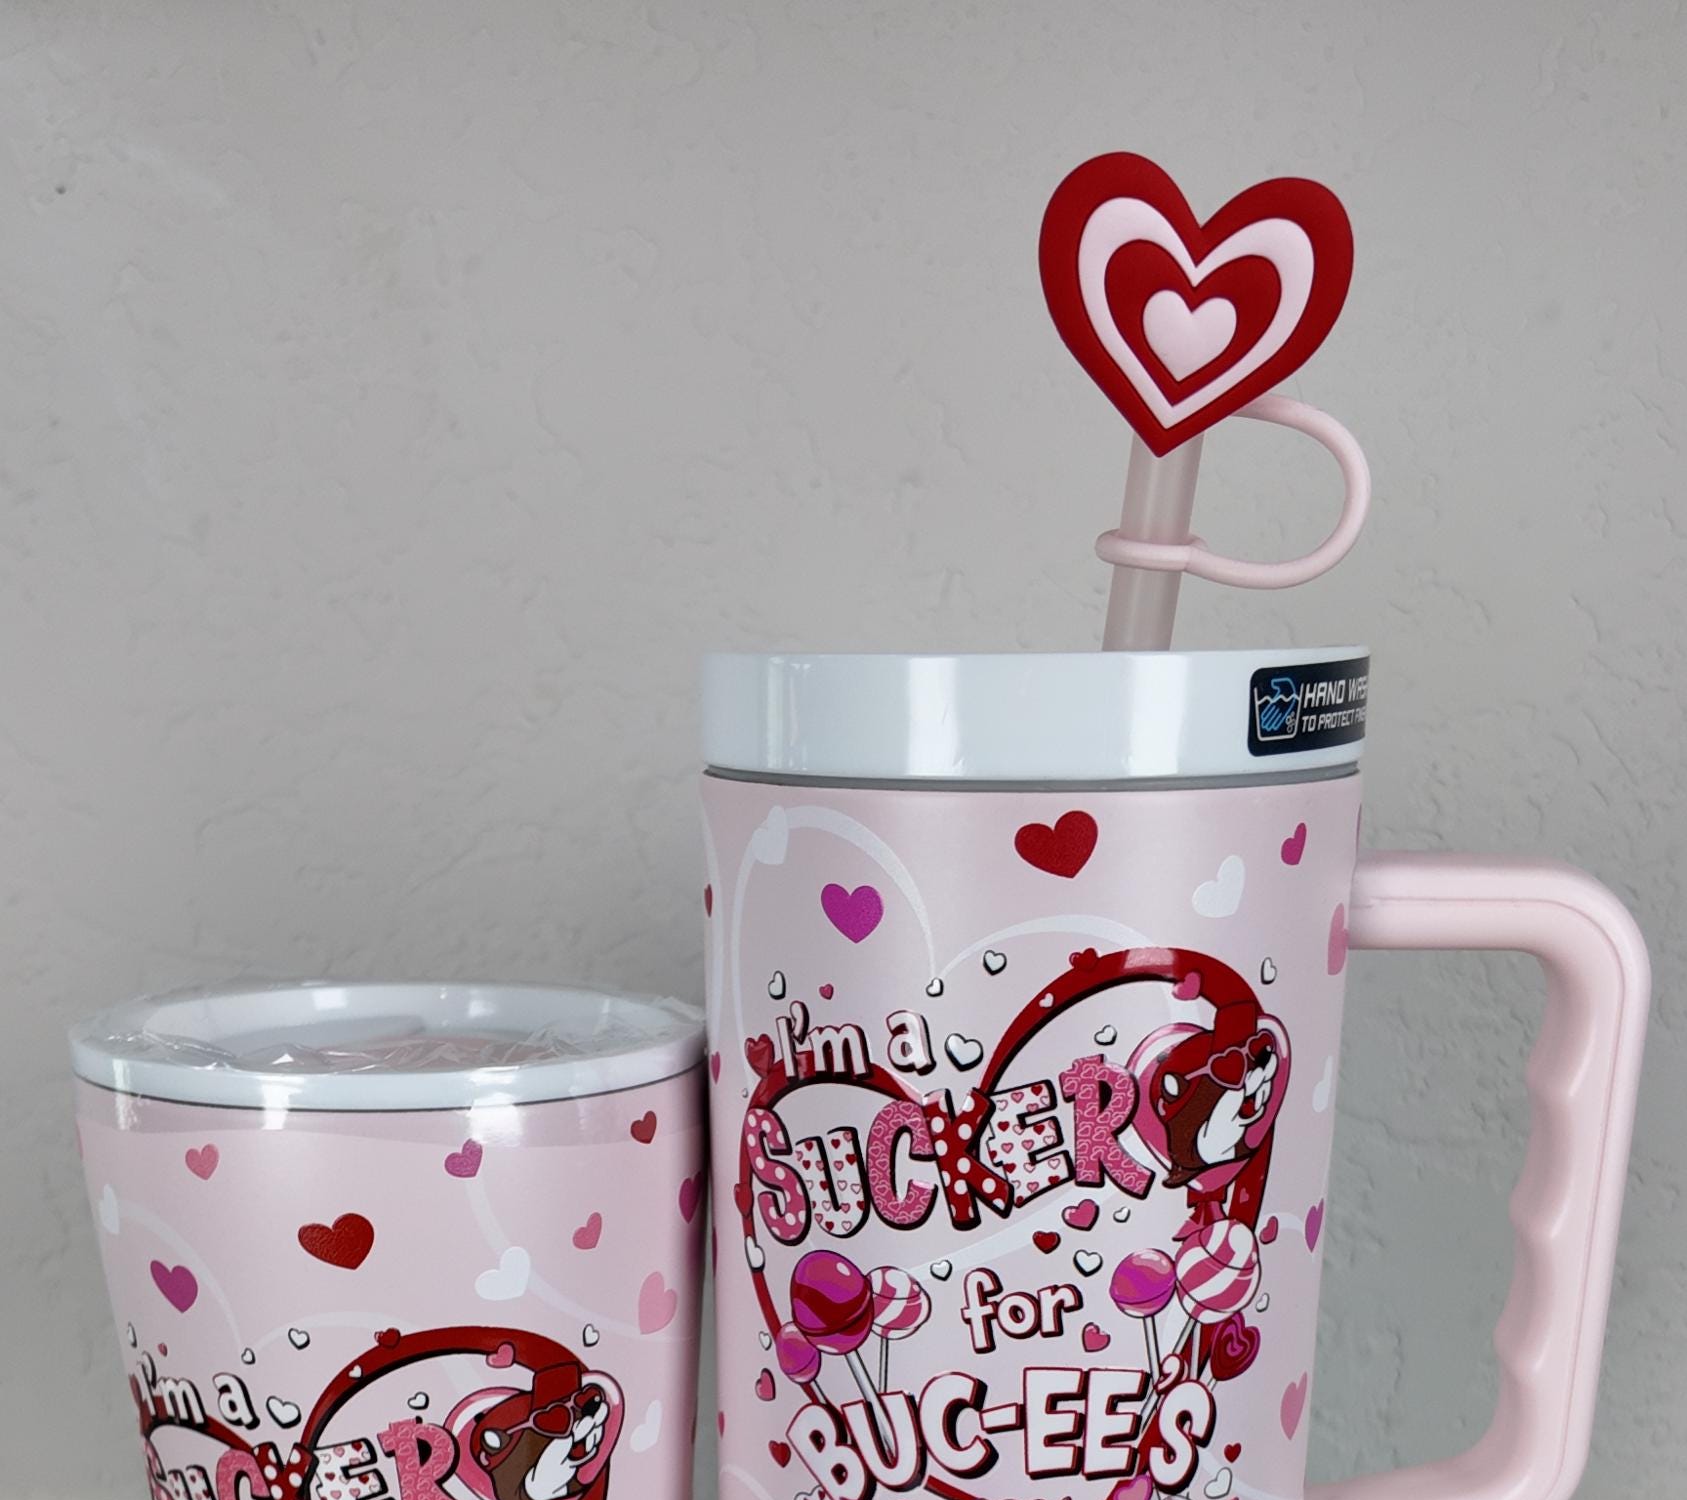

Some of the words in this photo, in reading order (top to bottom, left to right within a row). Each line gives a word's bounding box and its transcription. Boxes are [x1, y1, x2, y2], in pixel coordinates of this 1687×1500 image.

[1302, 715, 1316, 733] TO
[1317, 709, 1355, 731] PROTECT
[1303, 680, 1345, 708] HAND
[776, 1001, 873, 1080] I'm
[886, 1009, 935, 1074] a
[747, 1055, 1153, 1246] SUCKER
[961, 1268, 1082, 1353] for
[212, 1371, 260, 1430] a
